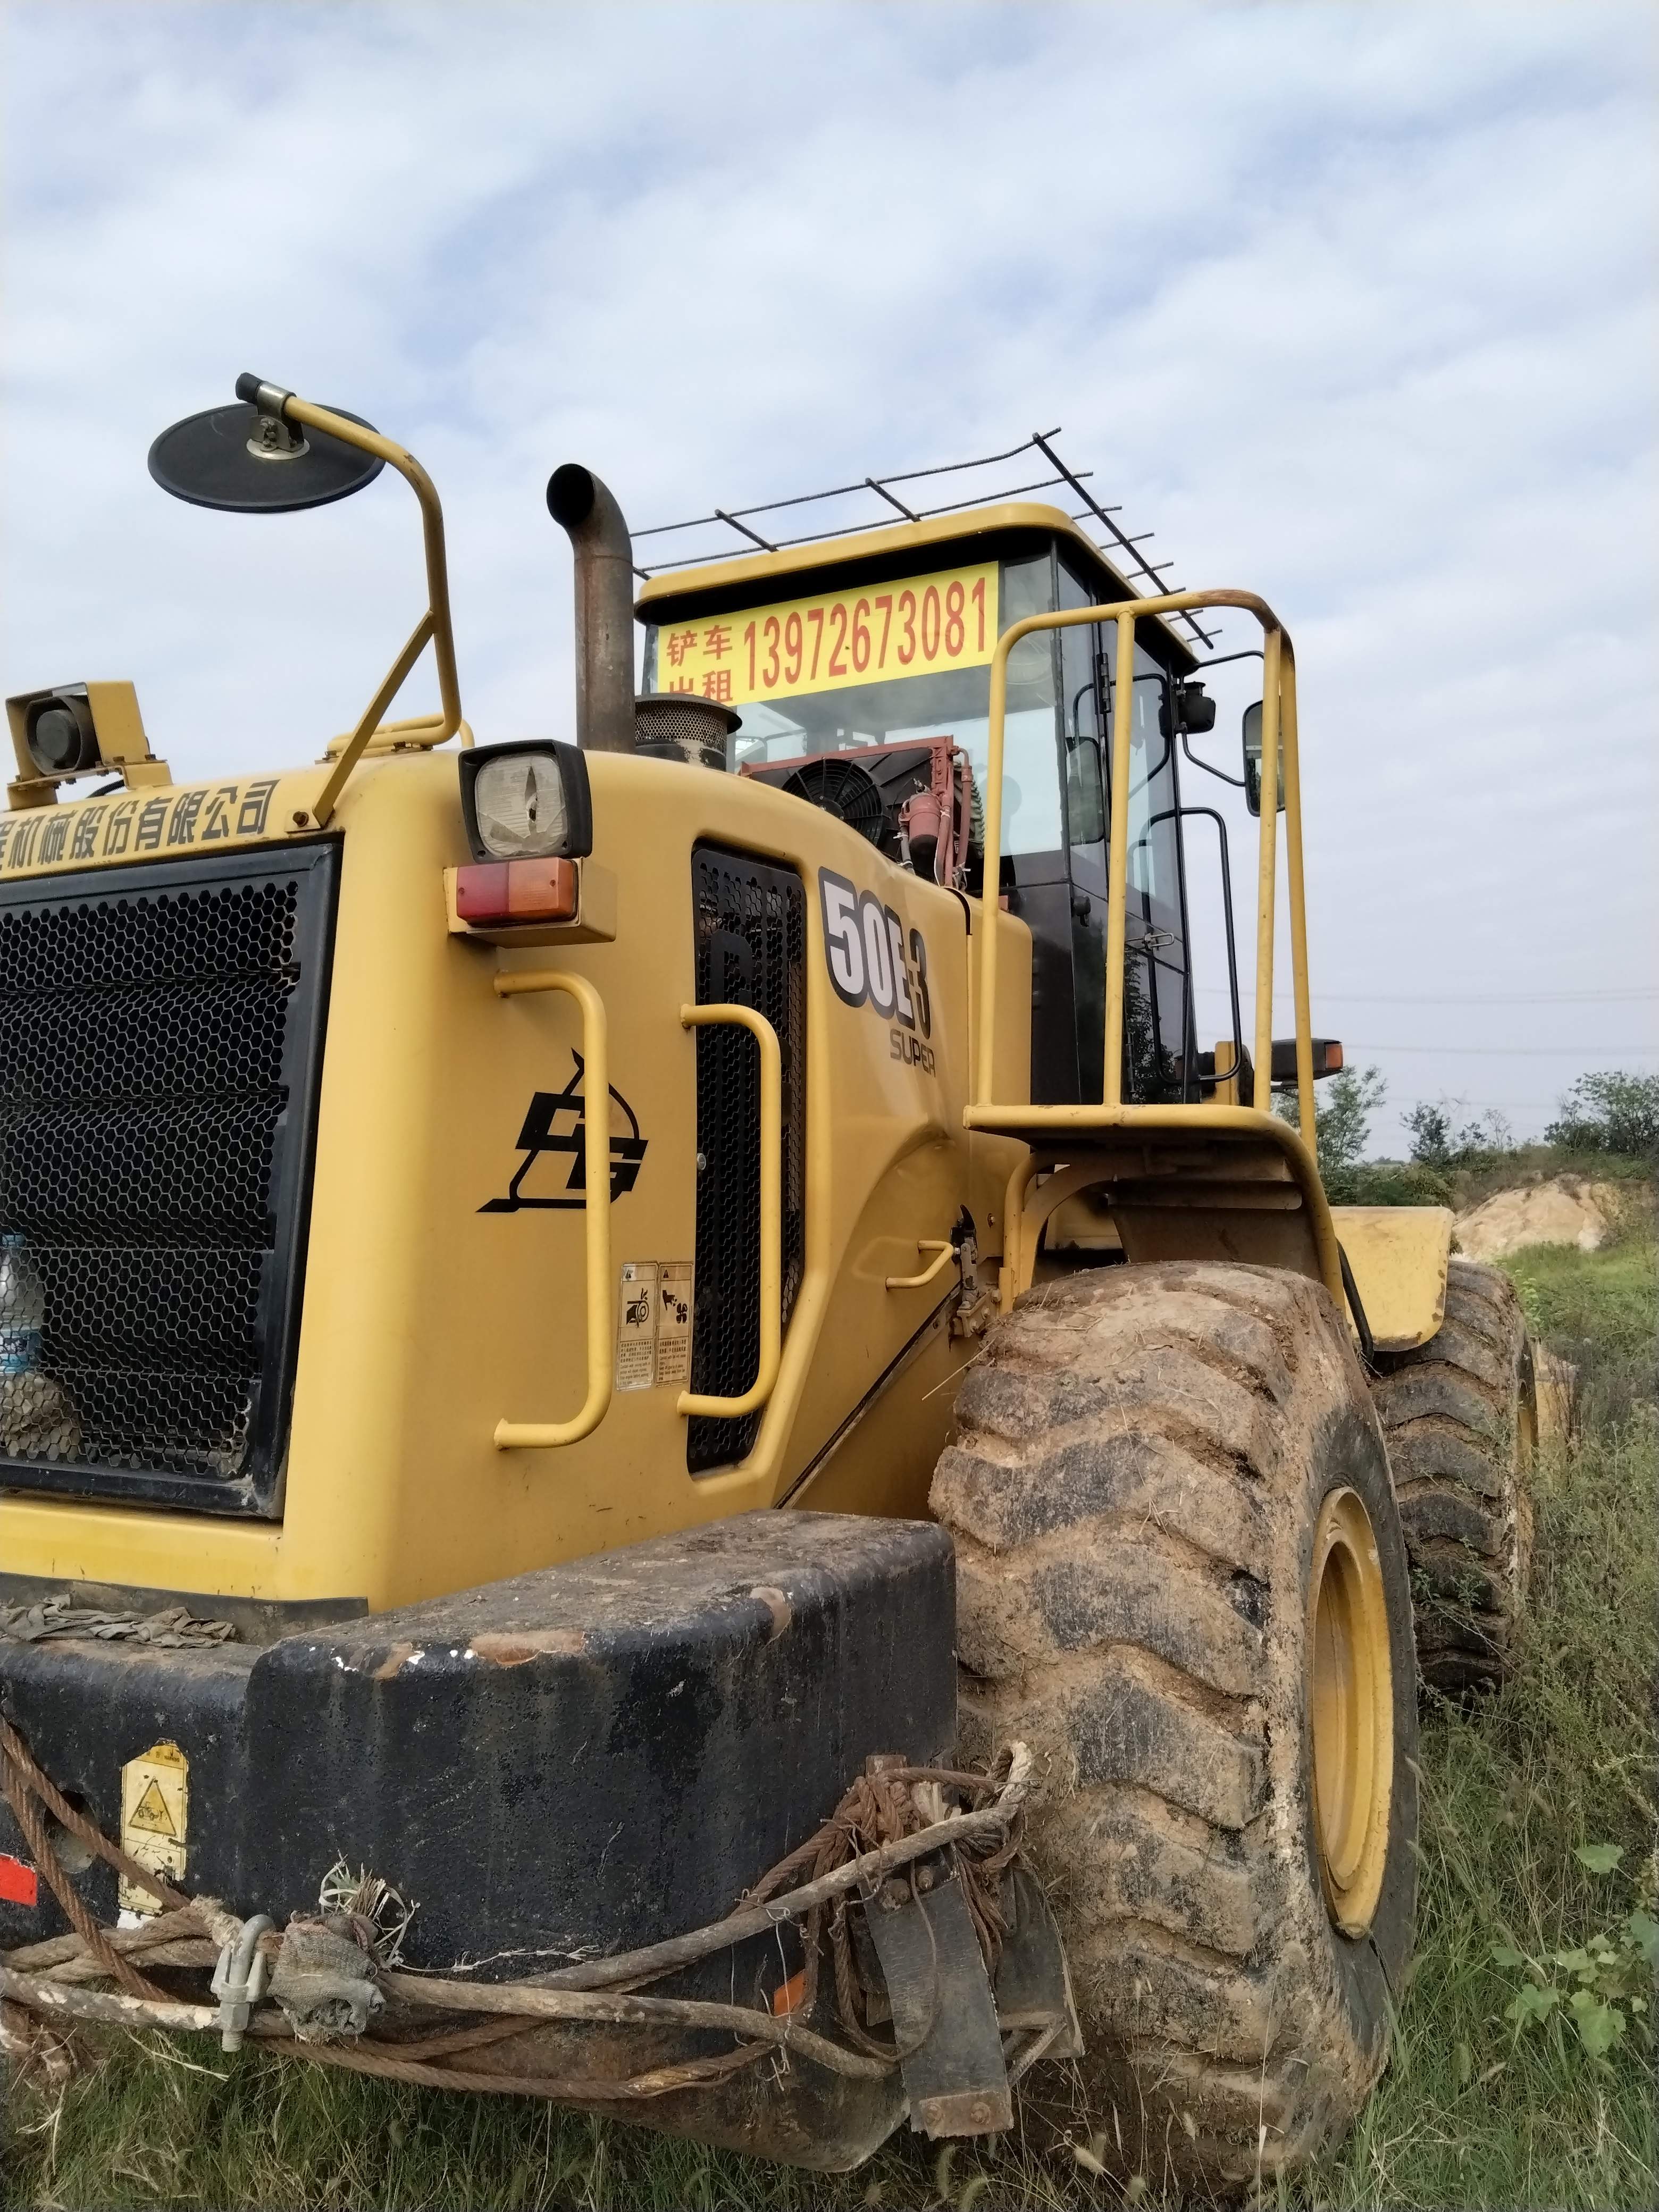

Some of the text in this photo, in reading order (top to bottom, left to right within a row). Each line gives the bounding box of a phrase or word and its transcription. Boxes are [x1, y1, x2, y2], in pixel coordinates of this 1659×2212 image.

[666, 625, 733, 667] 铲车
[744, 577, 987, 691] 13972673081
[890, 1028, 936, 1078] SUPER
